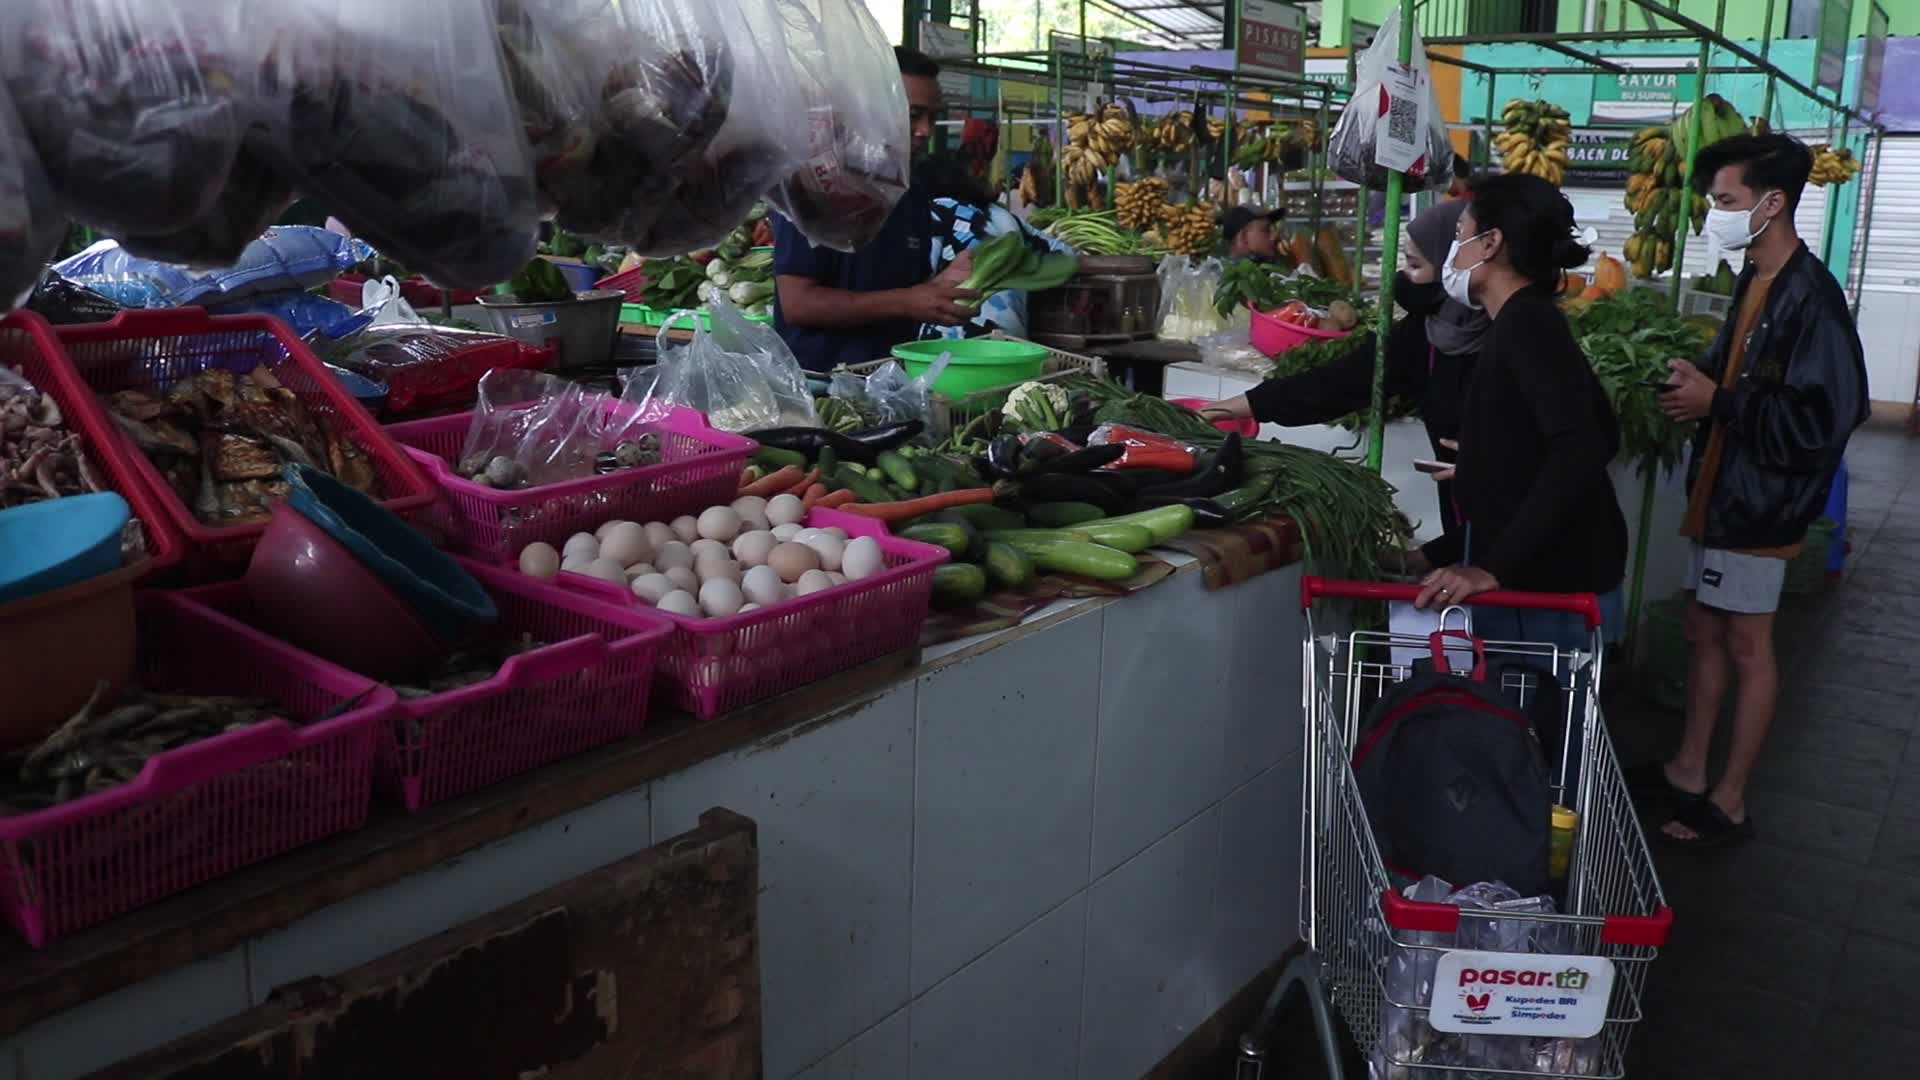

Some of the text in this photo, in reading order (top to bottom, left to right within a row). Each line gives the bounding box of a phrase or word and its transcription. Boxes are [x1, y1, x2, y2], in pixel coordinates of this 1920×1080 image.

[1245, 24, 1297, 49] PISANG
[1618, 74, 1677, 87] SAYUR
[1559, 997, 1577, 1006] BRI
